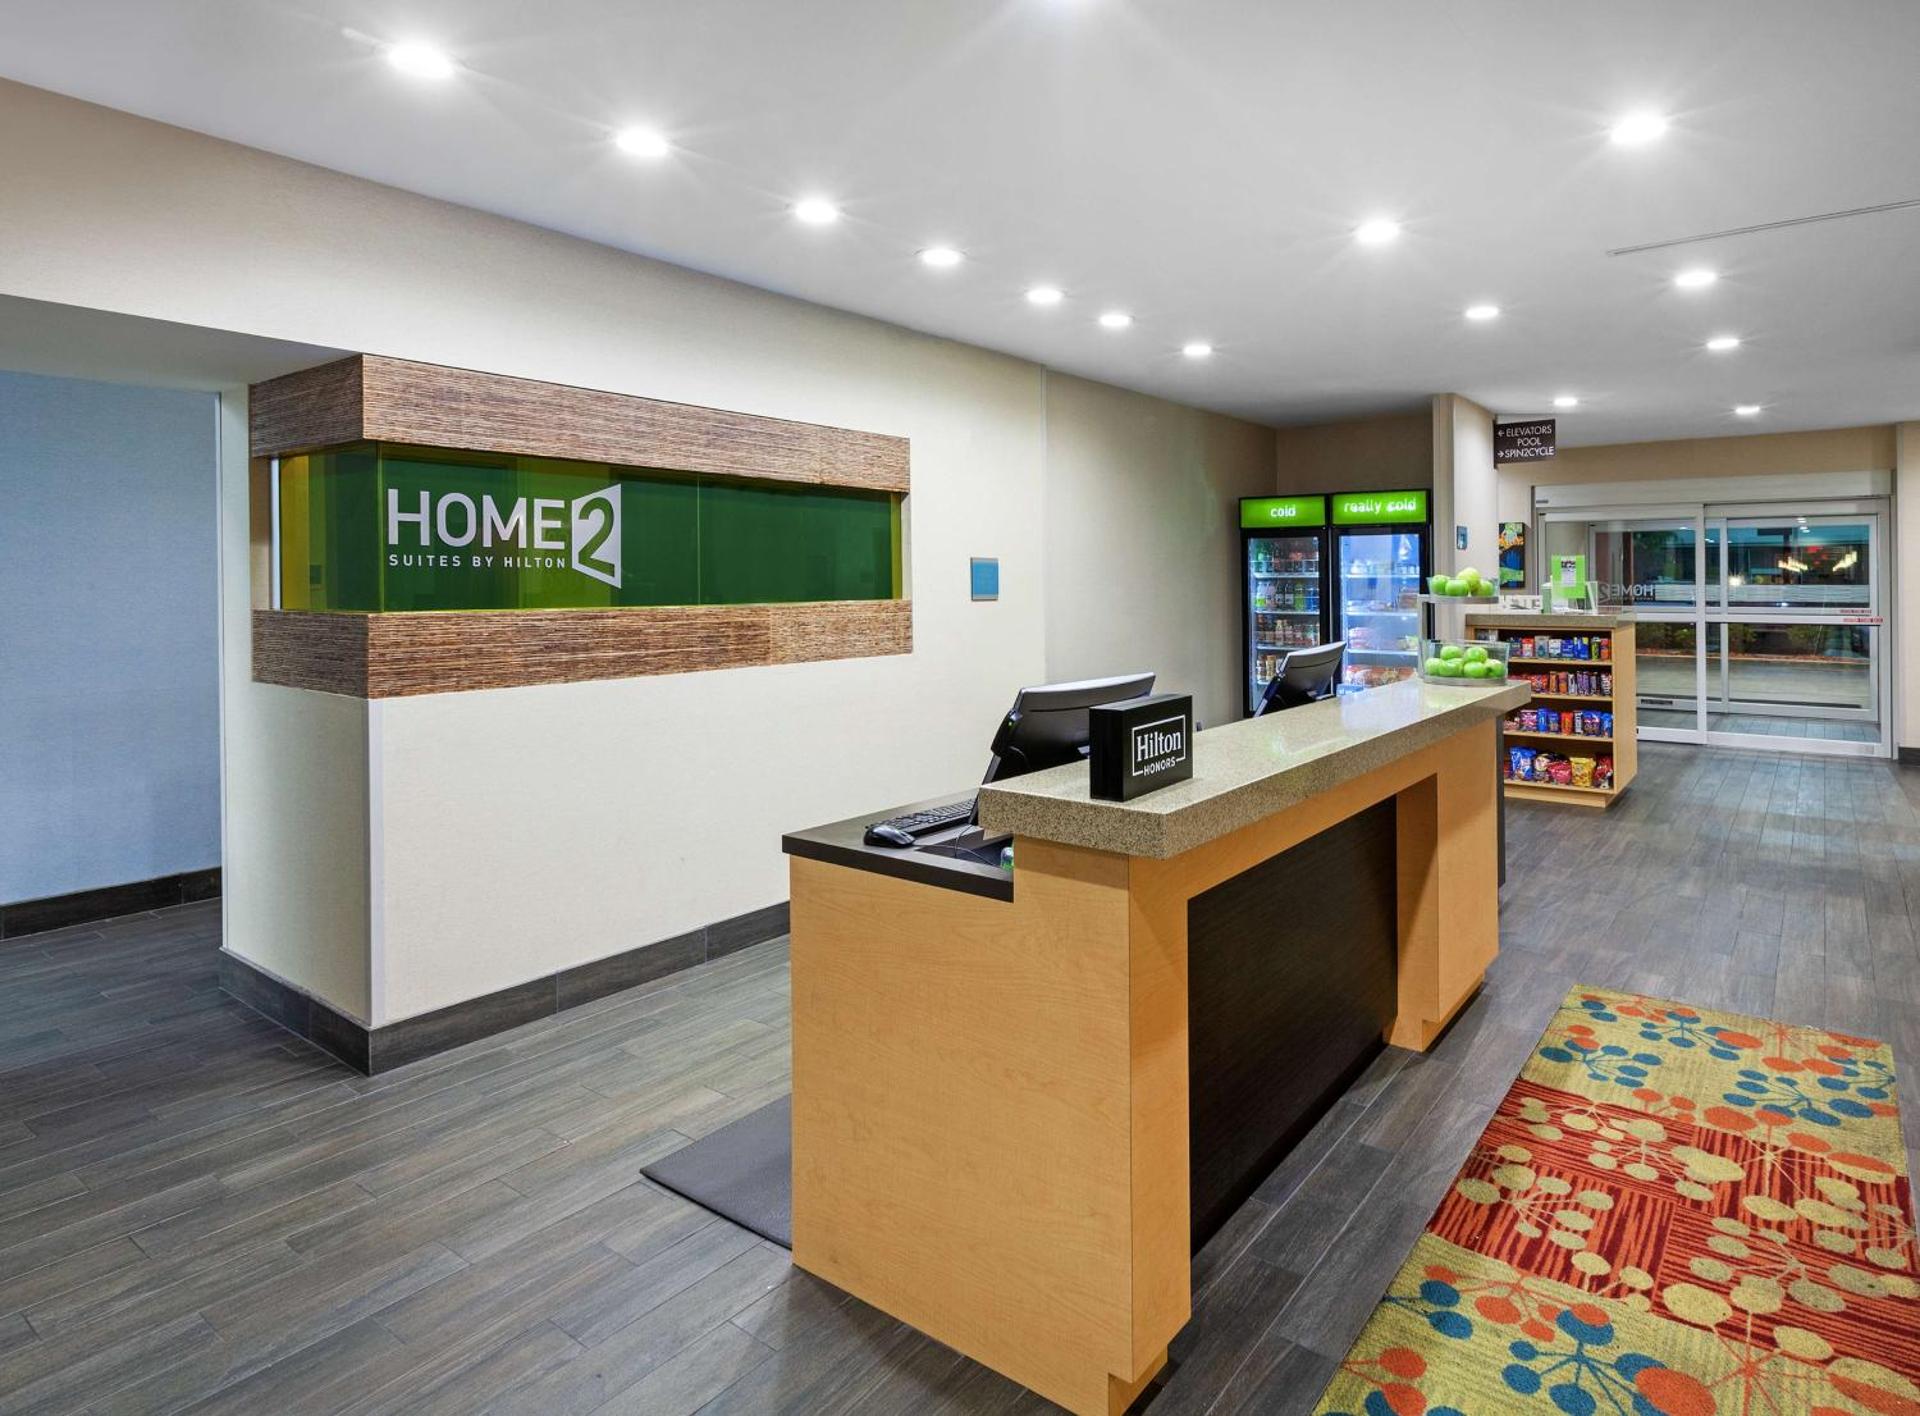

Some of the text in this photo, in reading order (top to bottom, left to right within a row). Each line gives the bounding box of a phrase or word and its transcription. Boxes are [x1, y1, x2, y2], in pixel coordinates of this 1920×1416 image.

[1506, 425, 1552, 437] ELEVATORS
[1517, 437, 1542, 446] POOL
[1505, 446, 1554, 457] SPIN2CYCLE
[1270, 504, 1297, 517] cold
[1344, 498, 1417, 514] really cold
[389, 554, 566, 568] SUITES BY HILTON
[1136, 731, 1181, 762] Hilton
[1144, 756, 1176, 776] HONORS
